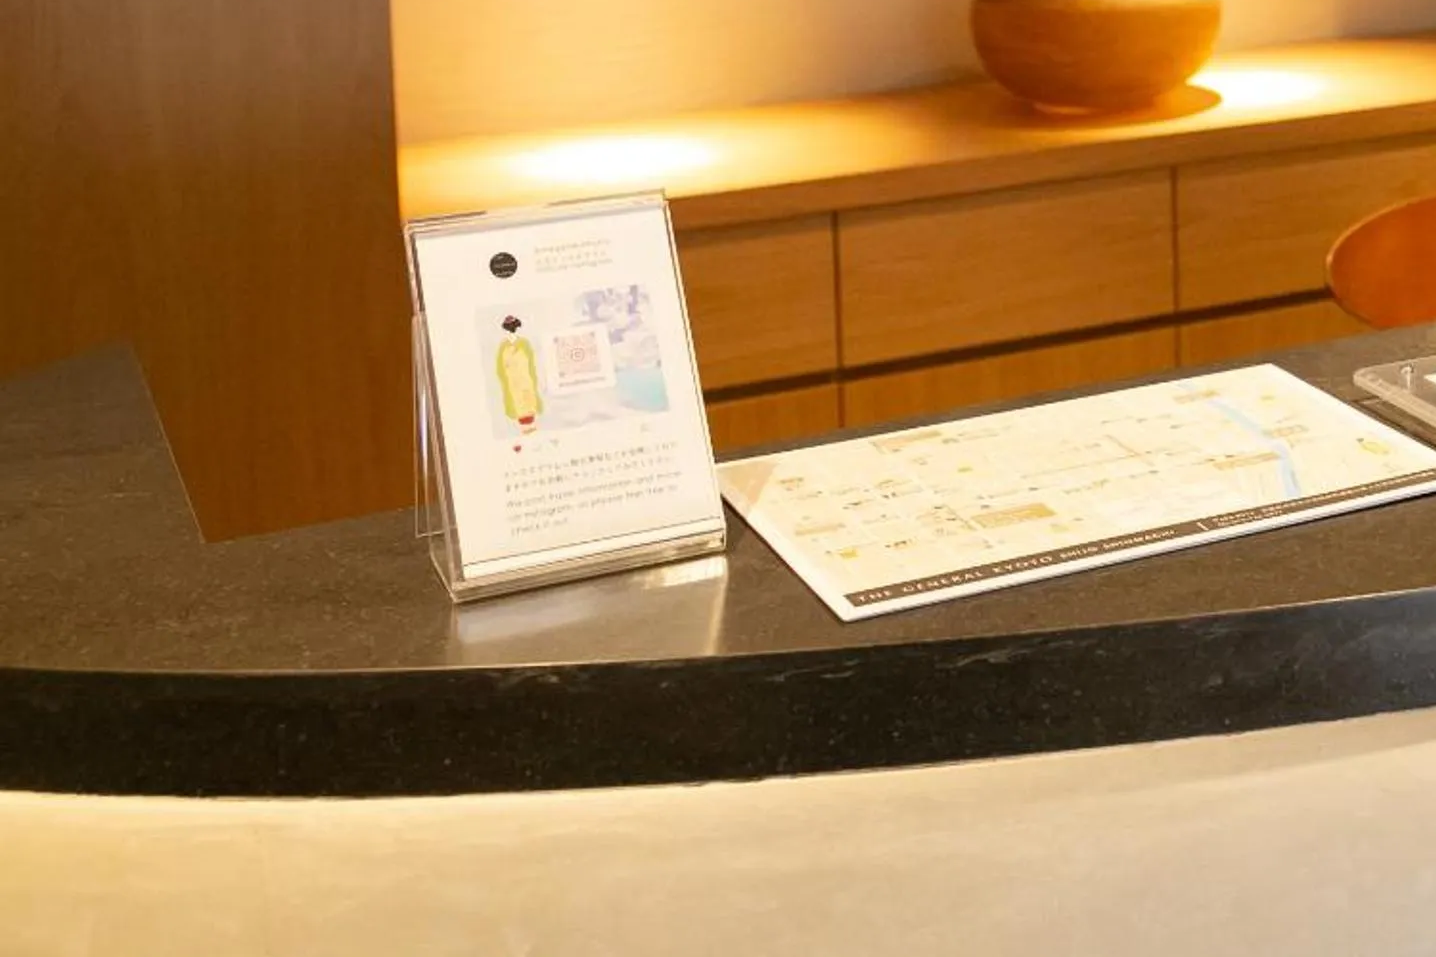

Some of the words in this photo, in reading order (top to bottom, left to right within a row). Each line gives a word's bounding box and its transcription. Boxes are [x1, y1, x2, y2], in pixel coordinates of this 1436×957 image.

[858, 589, 892, 603] THE
[902, 571, 984, 593] GENERAL
[992, 555, 1054, 574] KYOTO
